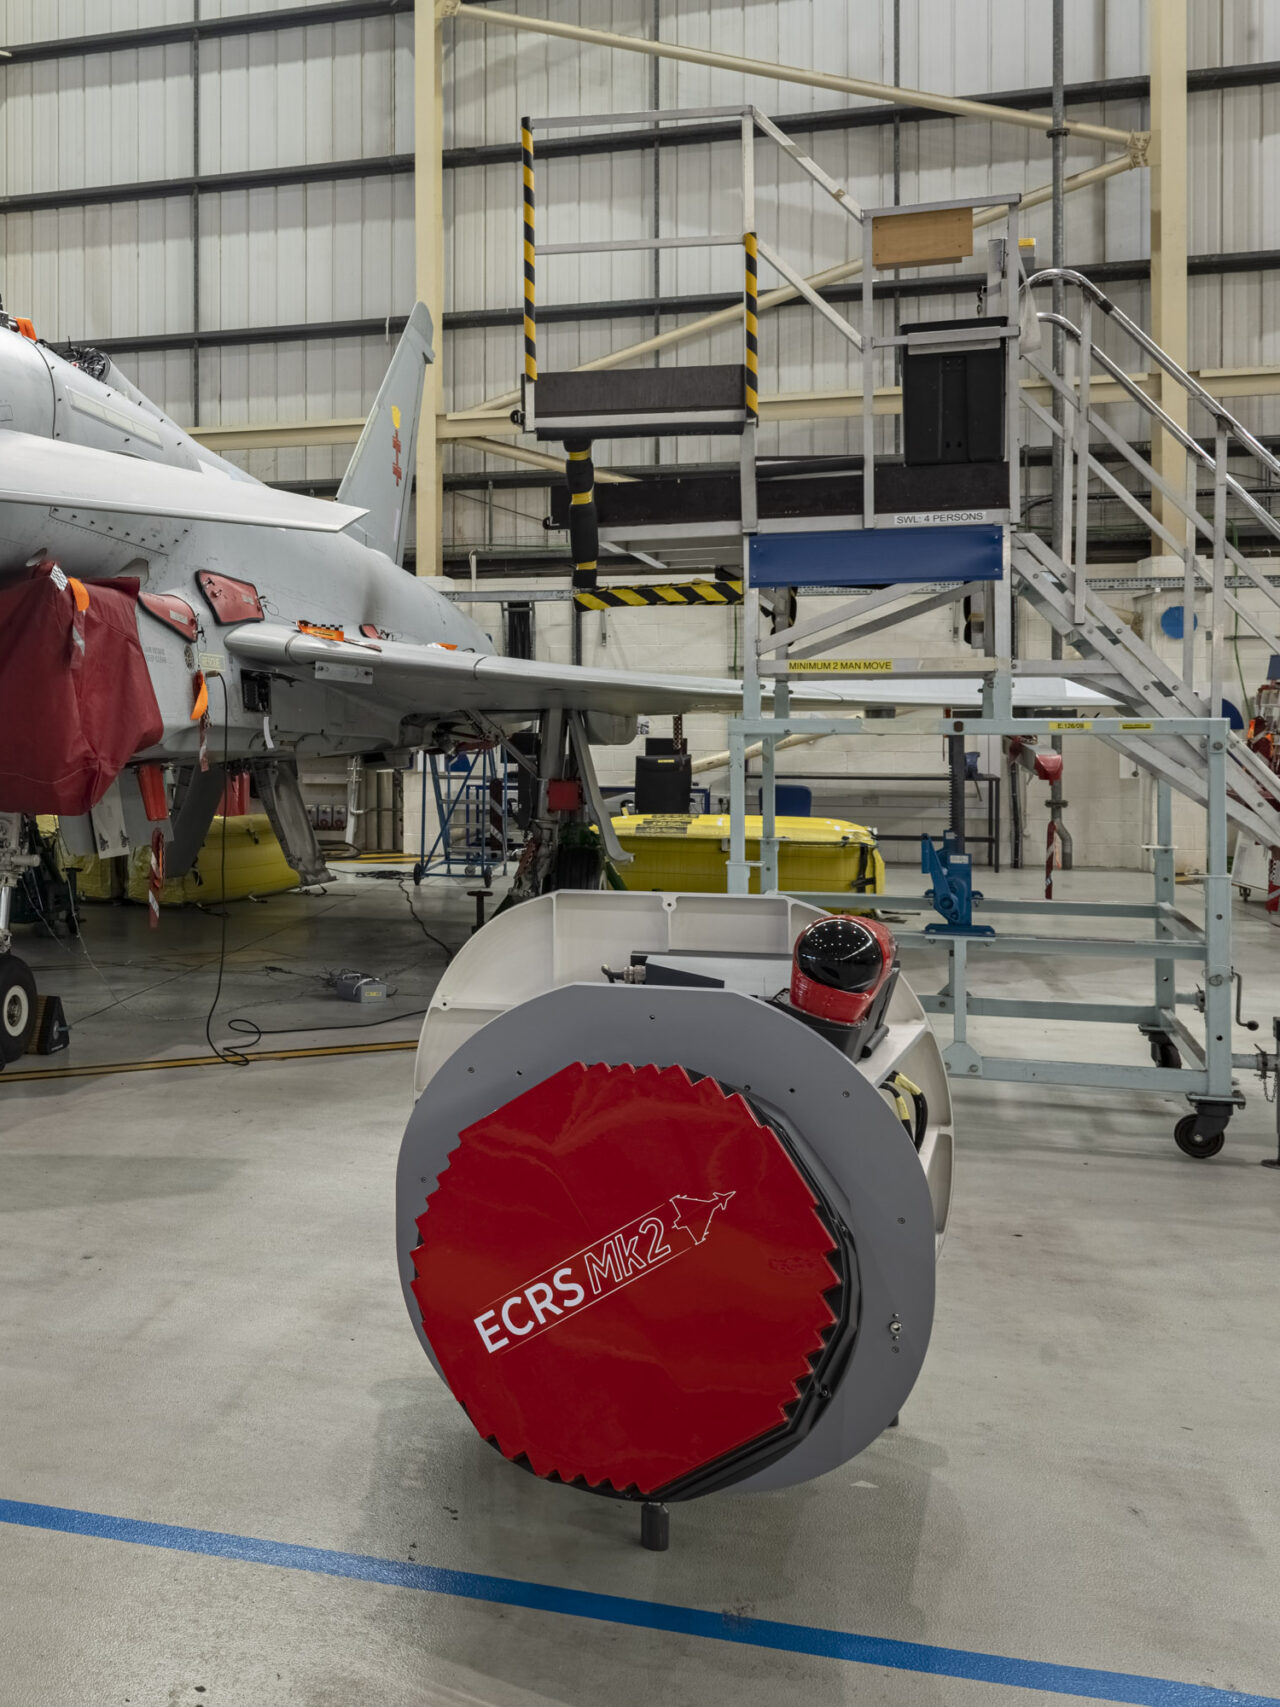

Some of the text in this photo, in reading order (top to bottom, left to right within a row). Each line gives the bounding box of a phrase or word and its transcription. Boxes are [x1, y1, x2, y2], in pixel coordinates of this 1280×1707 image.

[932, 512, 984, 522] PERSONS
[788, 661, 892, 670] MINIMUM 2 MAN MOVE
[473, 1217, 672, 1354] ECRS Mk2
